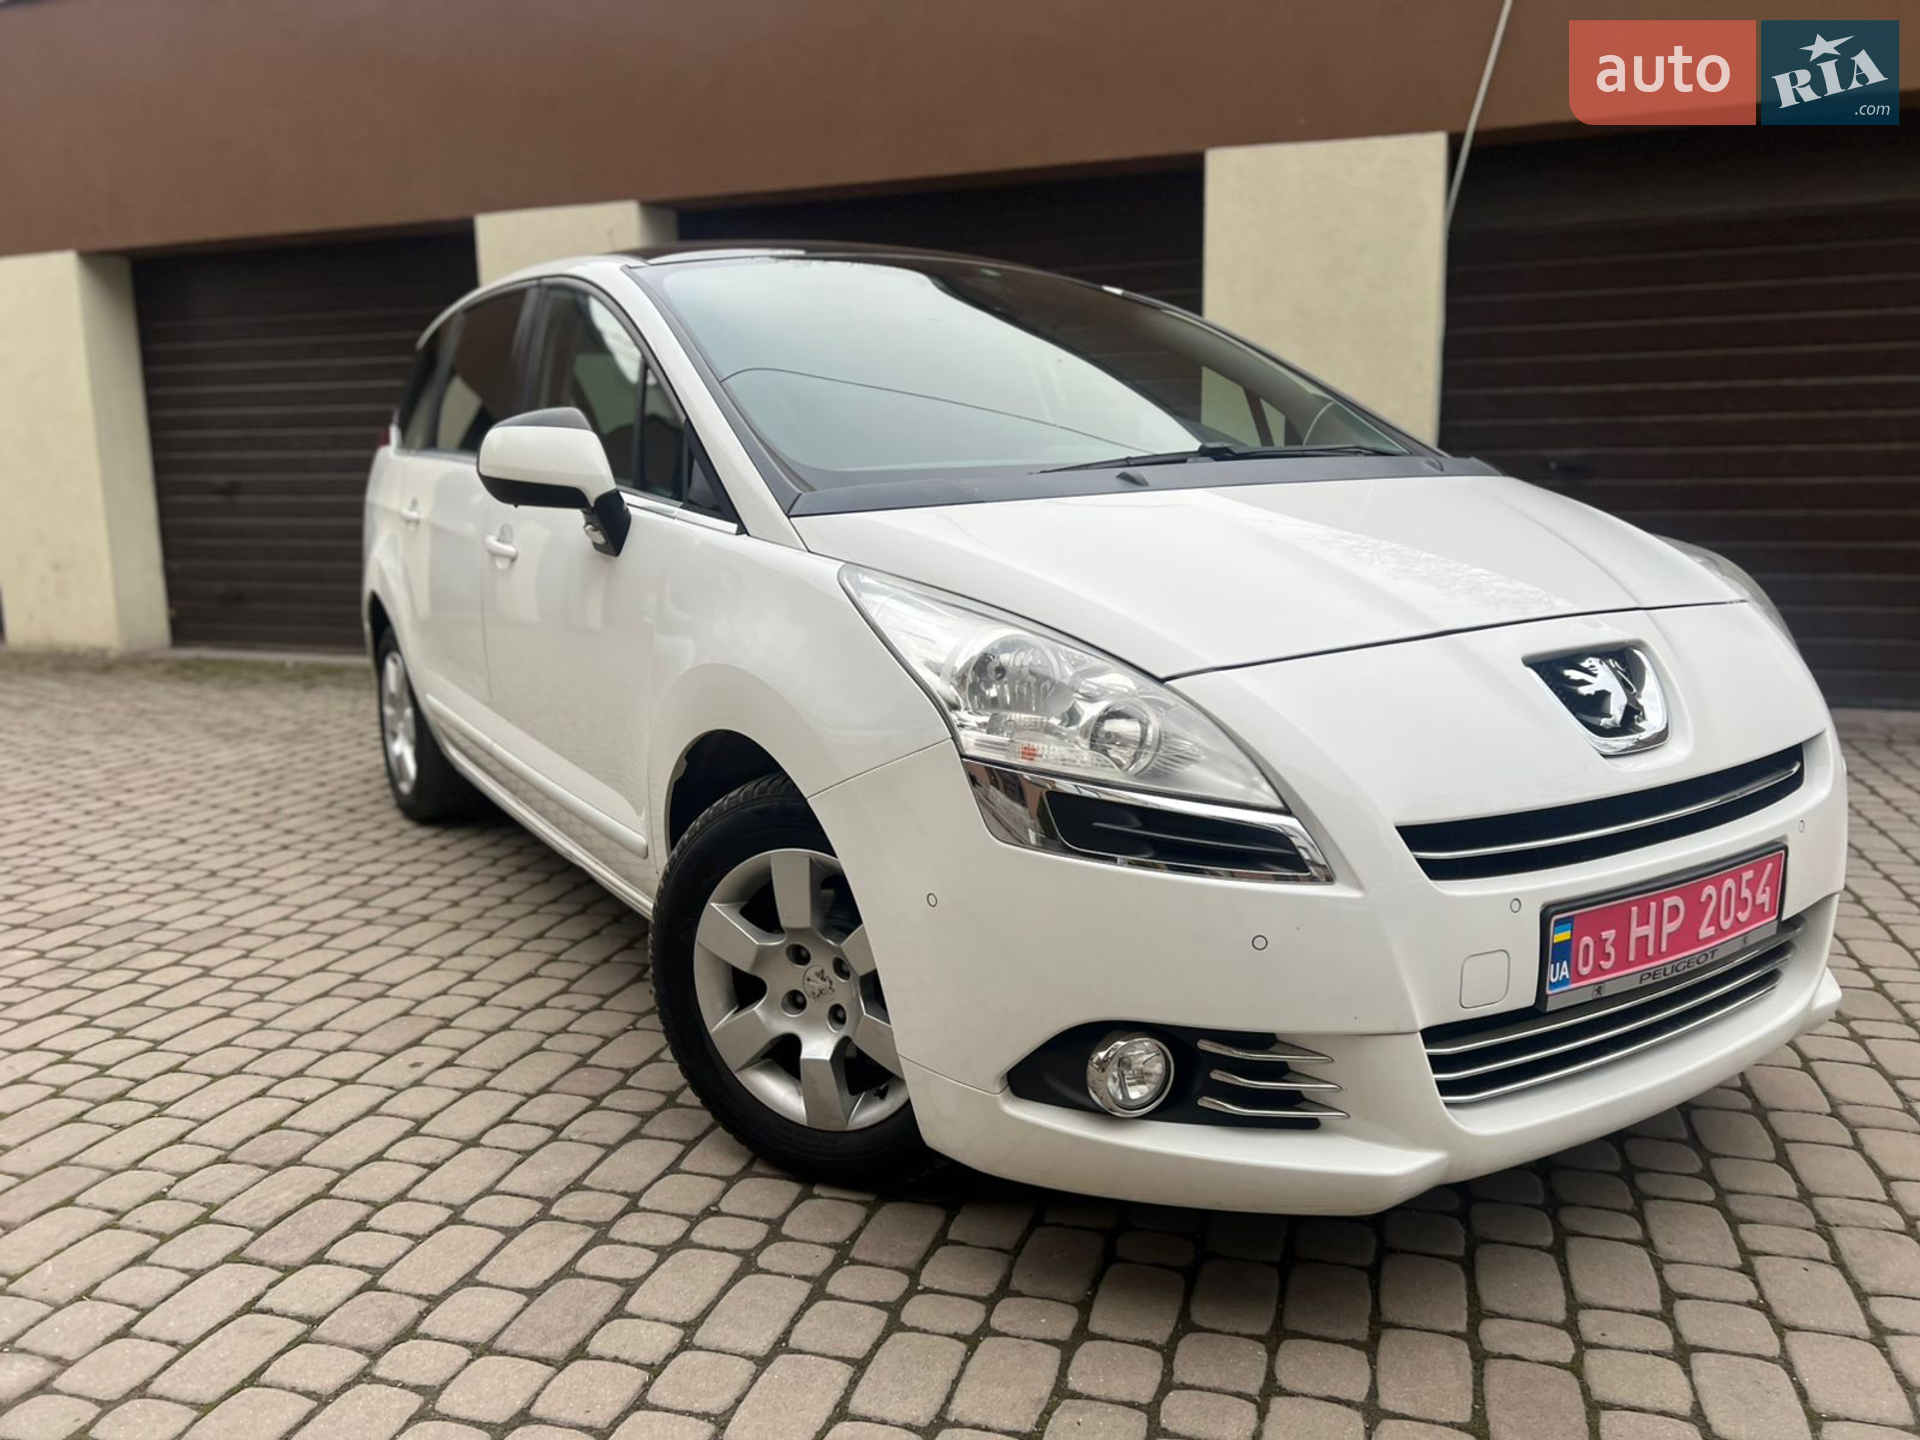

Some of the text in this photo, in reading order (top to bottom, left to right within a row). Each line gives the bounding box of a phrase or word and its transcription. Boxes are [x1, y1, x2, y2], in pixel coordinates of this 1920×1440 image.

[1577, 863, 1773, 976] 03 HP 2054
[1550, 960, 1570, 982] UA
[1639, 949, 1719, 985] PEUGEOT
